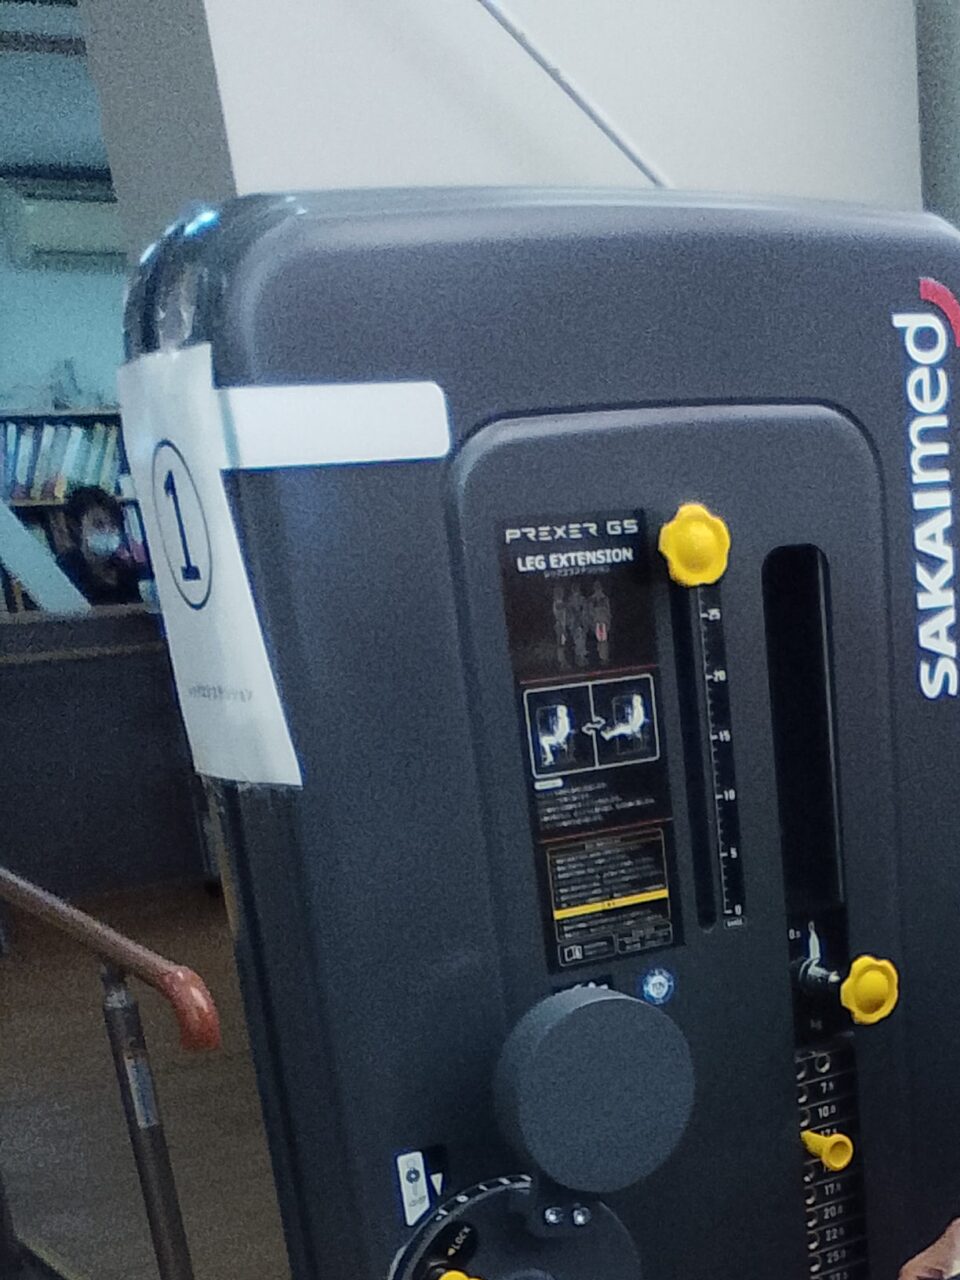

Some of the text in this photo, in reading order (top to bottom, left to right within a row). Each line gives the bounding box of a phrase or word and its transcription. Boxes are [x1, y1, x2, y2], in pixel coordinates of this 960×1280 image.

[891, 313, 959, 699] SAKAImed
[505, 519, 639, 544] PREXER GS
[516, 553, 546, 573] LEG
[548, 547, 635, 569] EXTENSION
[723, 788, 736, 802] 10
[730, 847, 738, 859] 5
[734, 904, 742, 916] 0
[451, 1225, 472, 1251] LOCK
